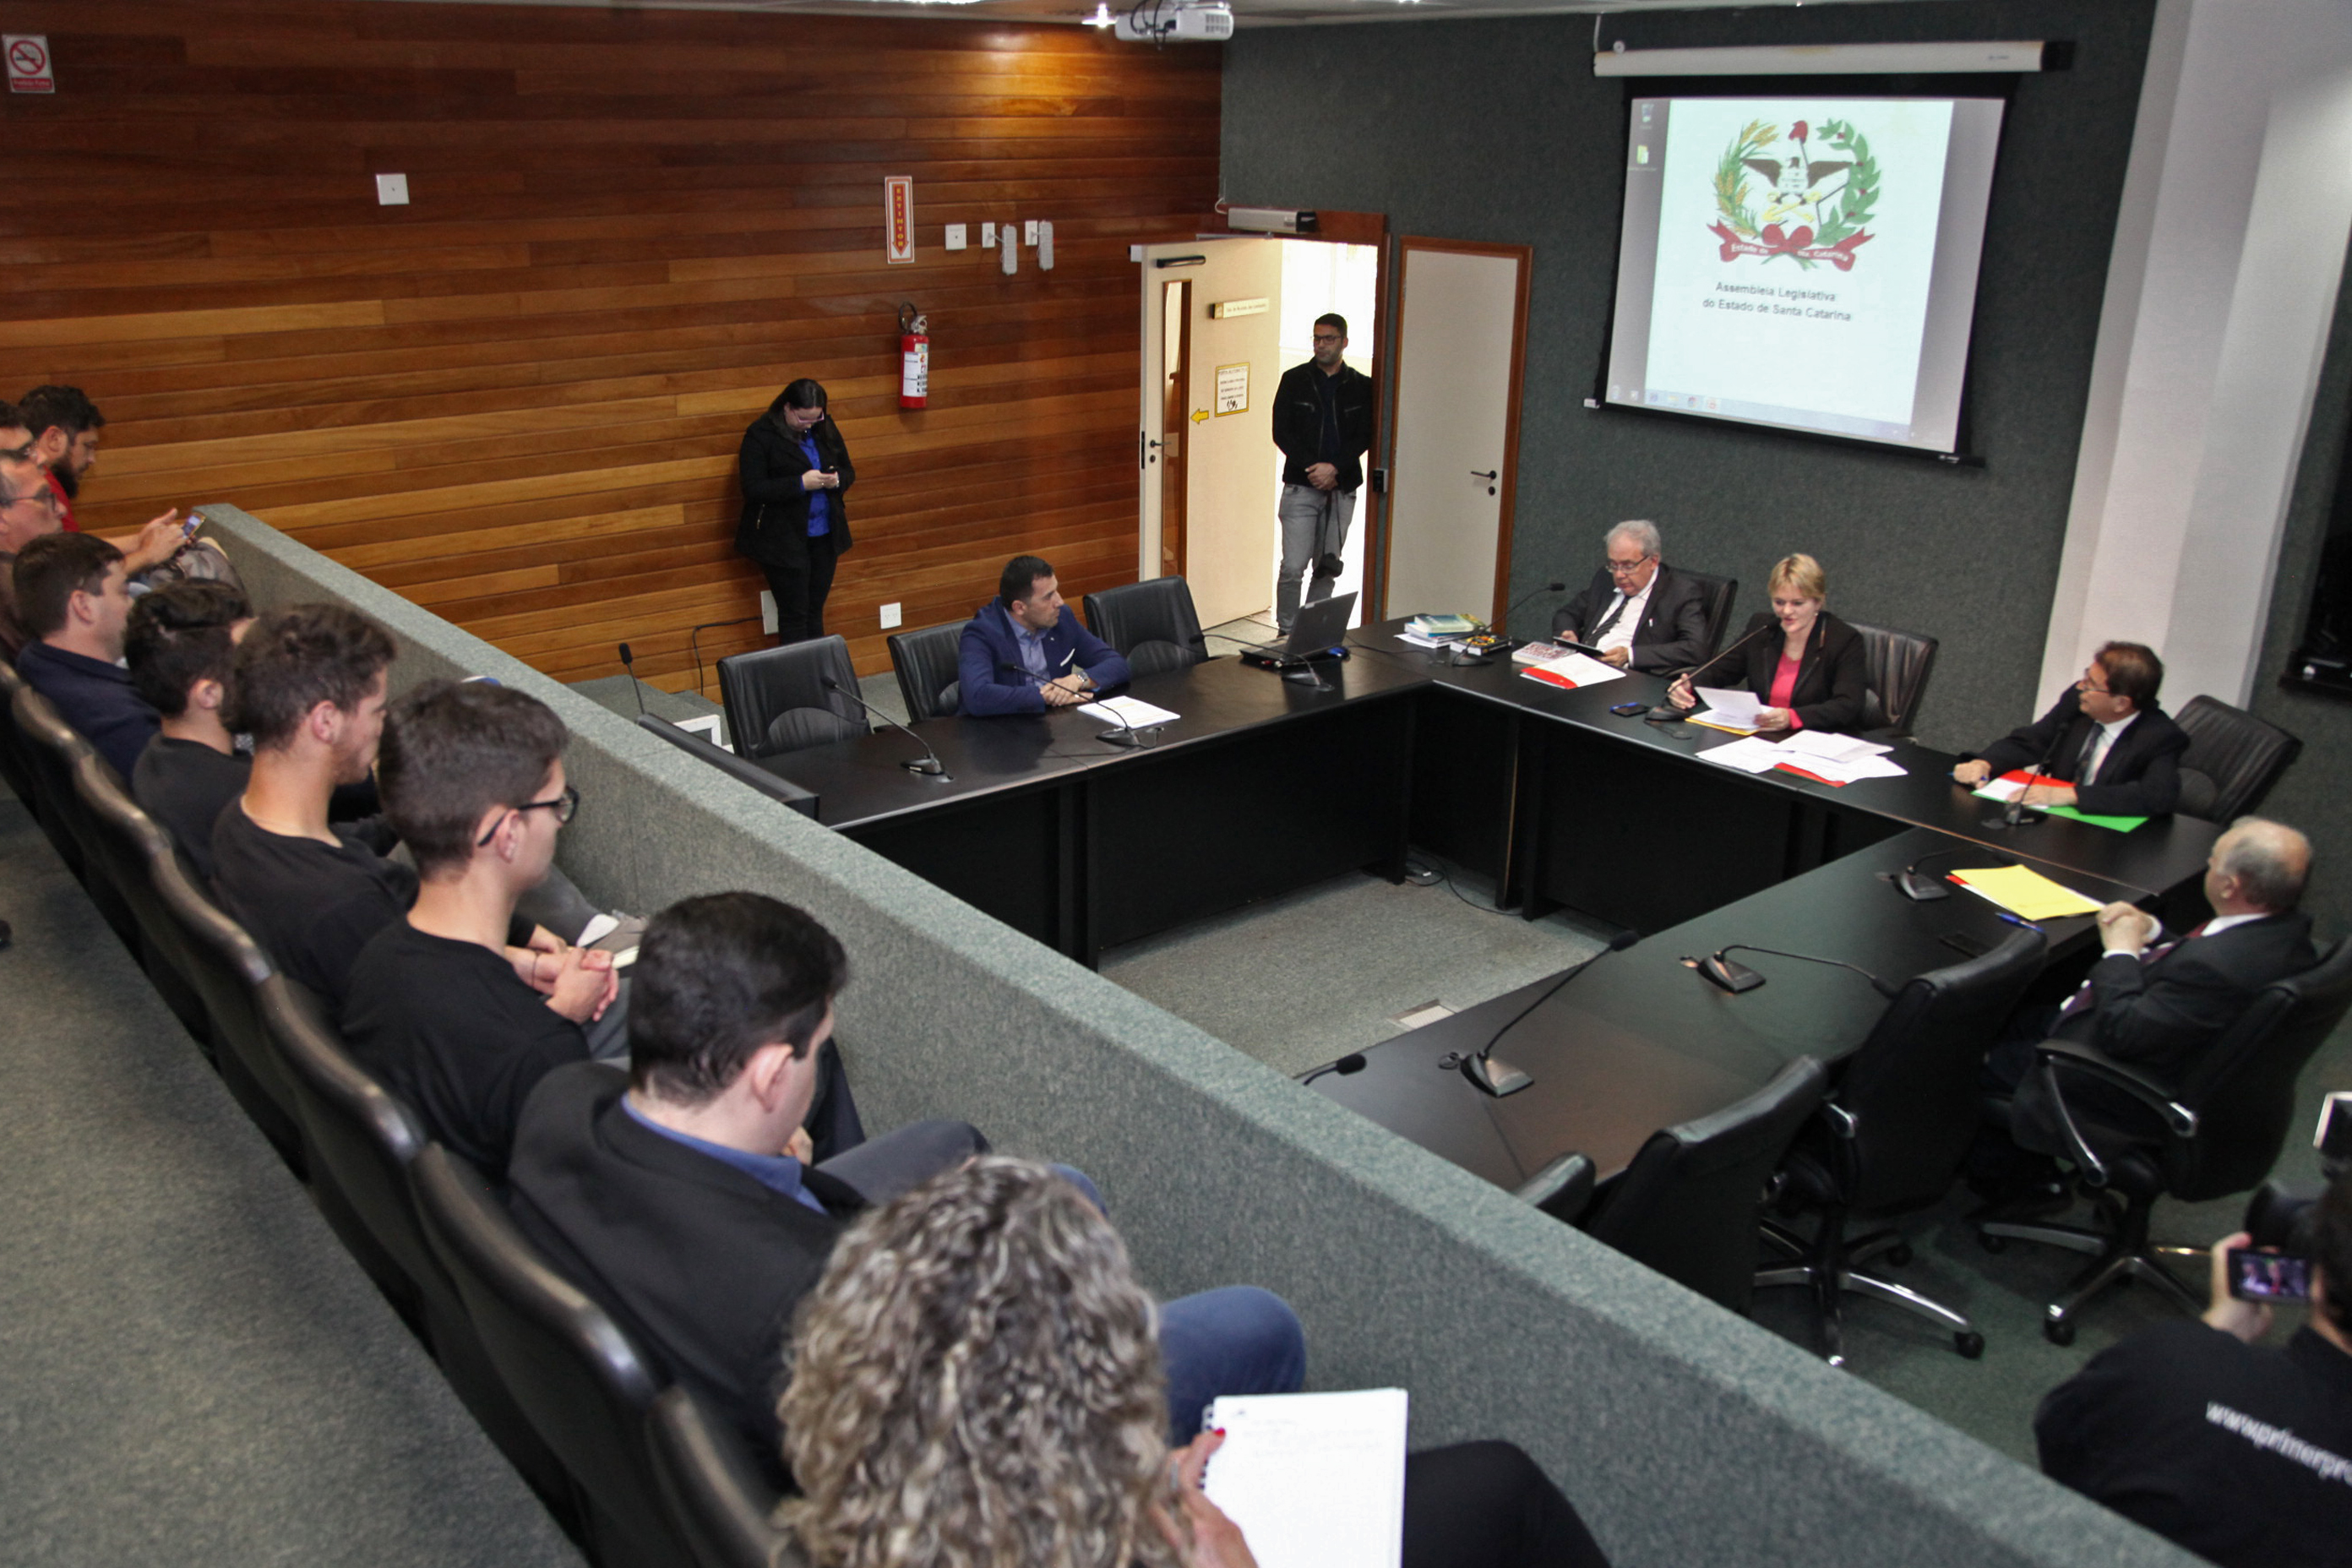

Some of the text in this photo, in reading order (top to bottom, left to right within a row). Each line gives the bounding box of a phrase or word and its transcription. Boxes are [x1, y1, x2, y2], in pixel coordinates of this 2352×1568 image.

[1716, 281, 1836, 302] Assembleia Legislativa
[1702, 298, 1851, 322] do Estado de Santa Catarina
